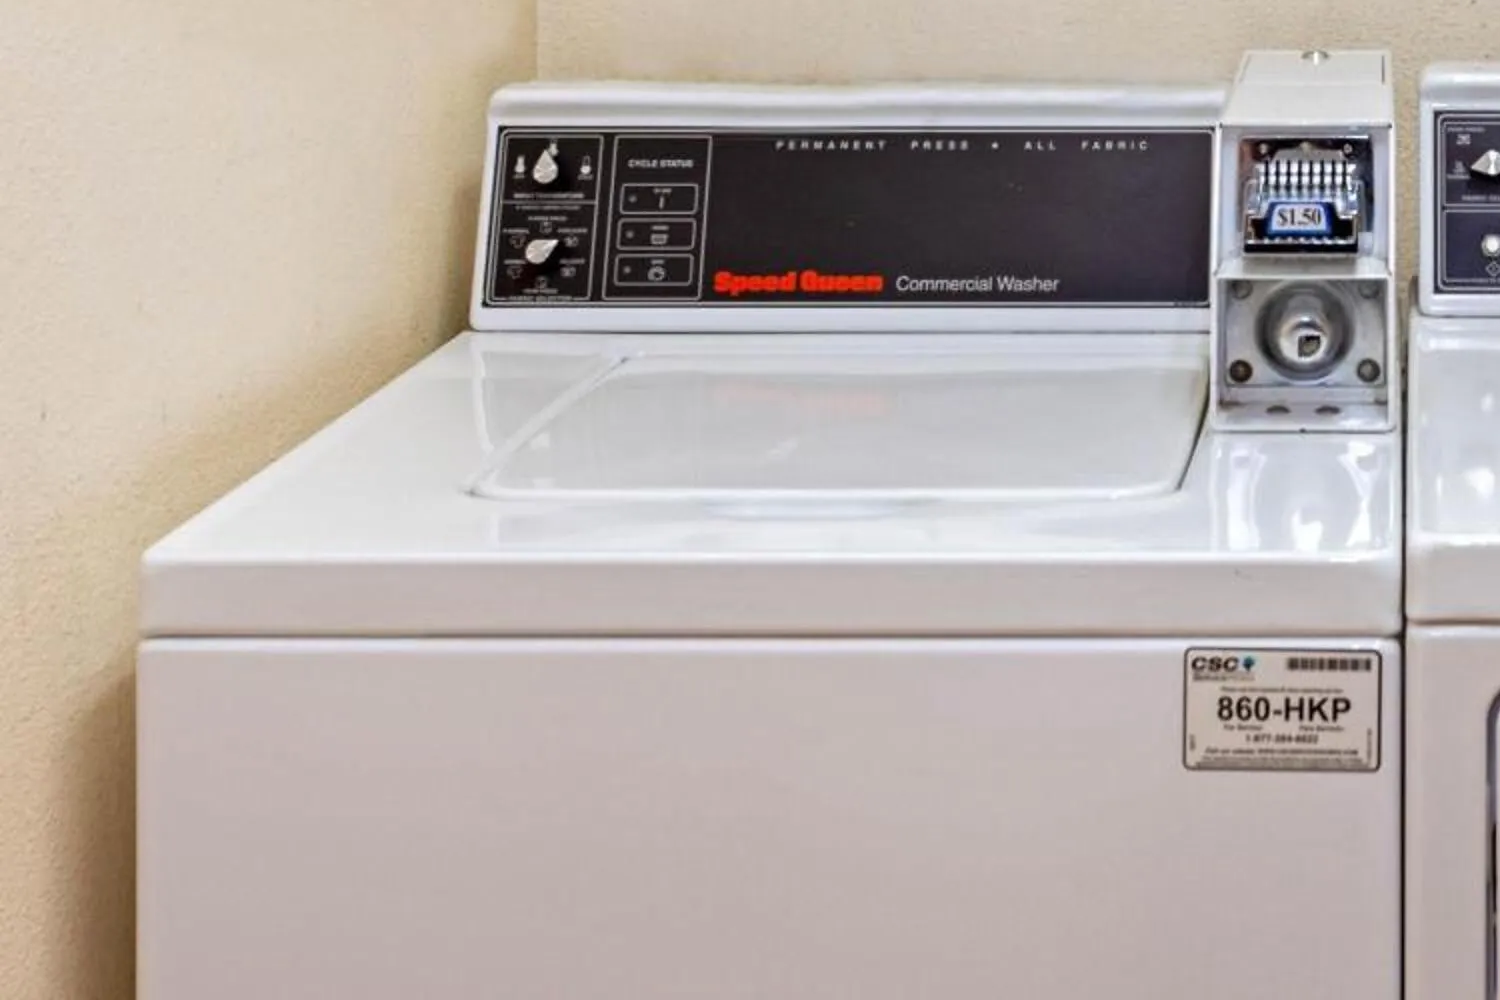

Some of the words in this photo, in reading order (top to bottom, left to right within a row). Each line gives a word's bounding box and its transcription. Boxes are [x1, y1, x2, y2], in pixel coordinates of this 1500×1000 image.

[775, 140, 888, 151] PERMANENT
[910, 140, 970, 151] PRESS
[1023, 140, 1057, 151] ALL
[1081, 140, 1149, 151] FABRIC
[628, 159, 658, 168] CYCLE
[660, 159, 694, 168] STATUS
[1277, 208, 1322, 227] $1.50
[714, 270, 797, 296] Speed
[799, 270, 884, 292] Queen
[896, 275, 993, 292] Commercial
[997, 275, 1061, 292] Washer
[1191, 656, 1240, 673] CSC
[1217, 696, 1351, 722] 860-HKP
